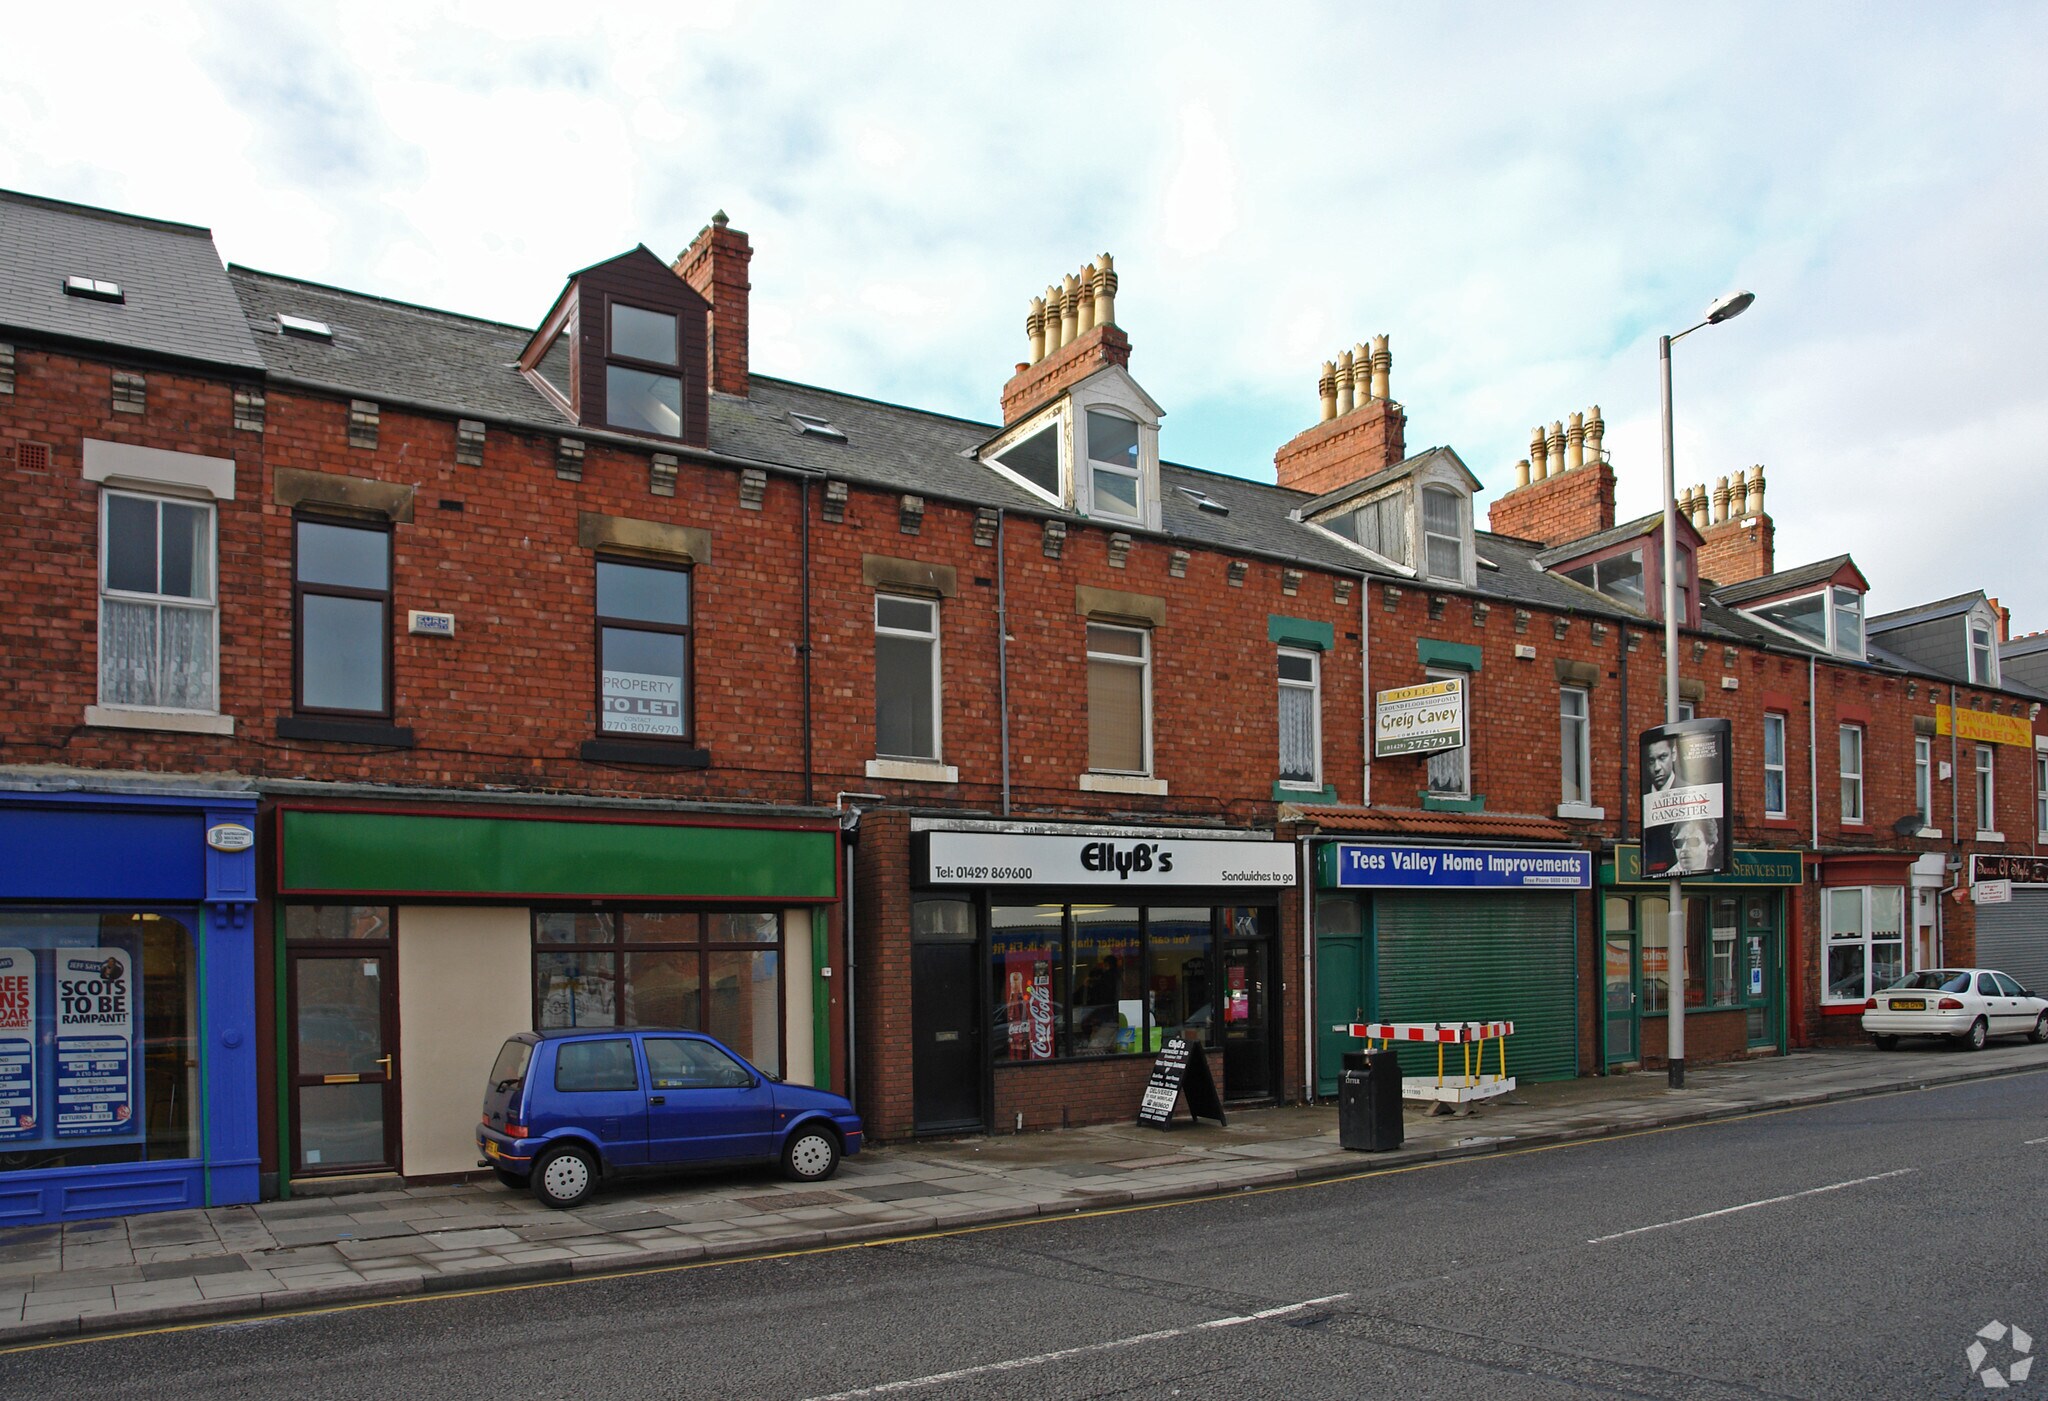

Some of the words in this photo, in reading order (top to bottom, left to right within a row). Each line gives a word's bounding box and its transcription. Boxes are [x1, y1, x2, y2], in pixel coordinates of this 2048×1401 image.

[603, 677, 674, 694] PROPERTY
[1394, 690, 1411, 699] TO
[1414, 685, 1438, 697] LET
[603, 697, 631, 712] TO
[637, 700, 676, 715] LET
[623, 715, 652, 723] CONTACT
[1381, 712, 1415, 732] Greig
[1417, 708, 1459, 724] Cavey
[630, 722, 680, 734] 8076970
[1397, 728, 1441, 738] COMMERCIAL
[1944, 722, 2027, 745] SUNBEDS
[1407, 736, 1455, 750] 275791
[1652, 793, 1708, 810] AMERICAN
[1652, 805, 1709, 823] GANGSTER
[1080, 843, 1173, 880] EllyB's
[1350, 851, 1386, 869] Tees
[1391, 852, 1437, 875] Valley
[1443, 853, 1483, 871] Home
[1488, 855, 1581, 876] Improvements
[1732, 857, 1776, 877] SERVICES
[1776, 864, 1793, 877] LTD
[1976, 856, 1998, 875] Sense
[935, 866, 953, 879] Tel:
[956, 867, 989, 879] 01429
[991, 867, 1033, 880] 869600
[1221, 870, 1272, 882] Sandwiches
[1272, 872, 1281, 882] to
[1282, 874, 1294, 884] go
[61, 997, 92, 1014] TO
[98, 996, 126, 1013] BE
